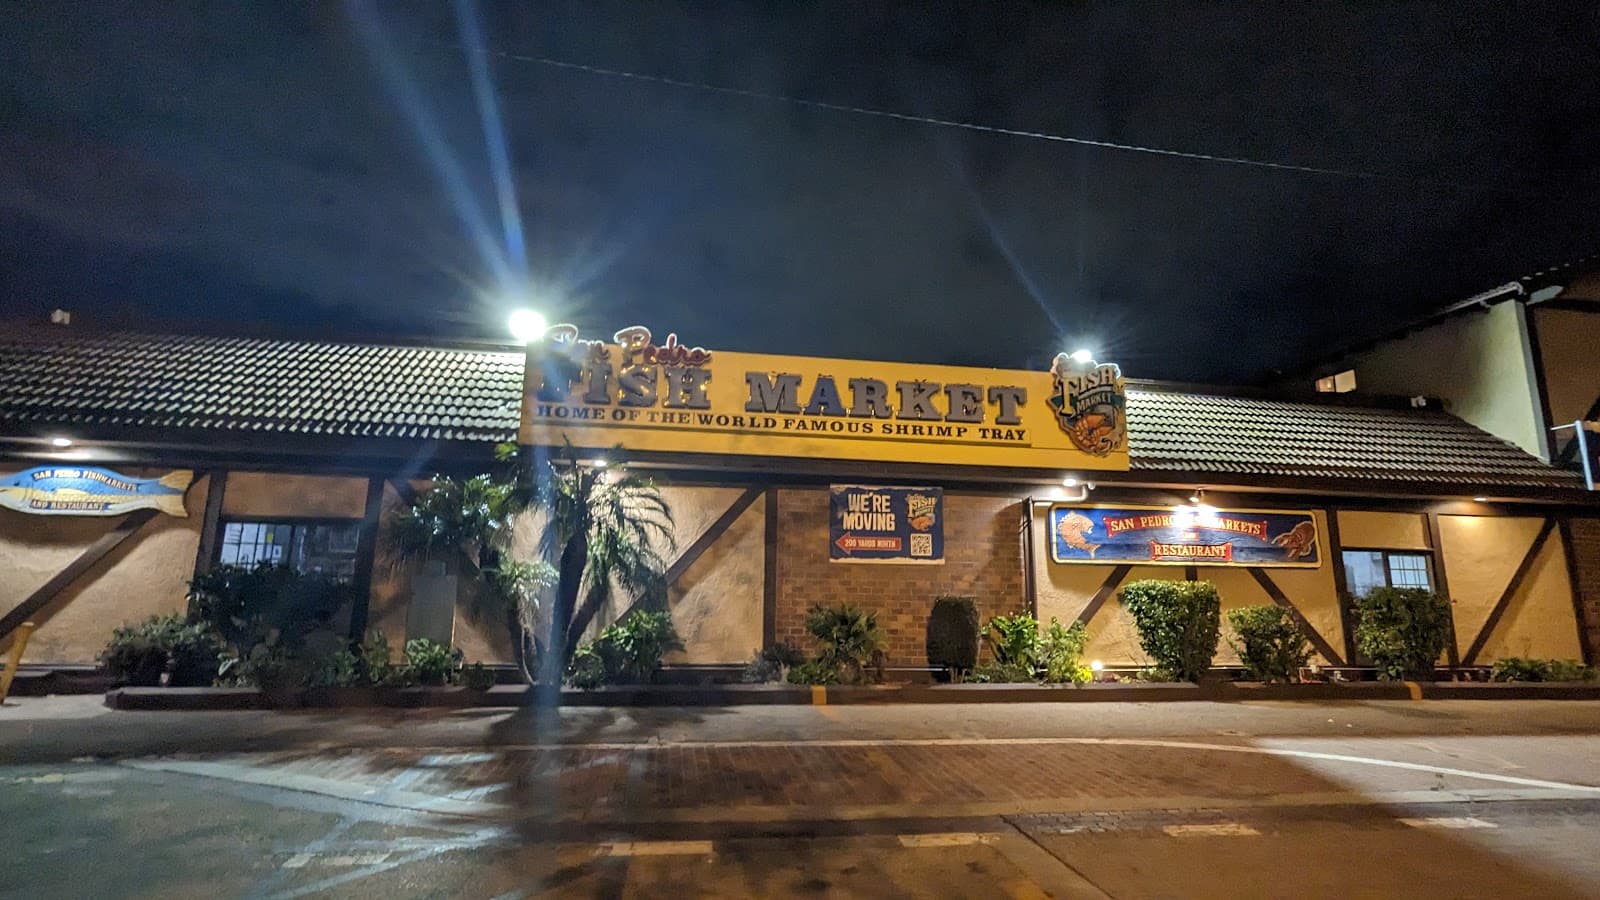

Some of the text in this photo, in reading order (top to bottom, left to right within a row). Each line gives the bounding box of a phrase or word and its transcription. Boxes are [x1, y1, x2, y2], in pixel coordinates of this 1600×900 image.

[613, 325, 713, 367] Pedro
[536, 362, 1028, 426] FISH MARKET
[1061, 366, 1115, 414] FISH
[1075, 393, 1112, 412] MARKET
[537, 405, 1027, 442] HOME OF THE WORLD FAMOUS SHRIMP TRAY
[33, 469, 51, 481] SAN
[31, 500, 47, 509] AND
[847, 492, 891, 513] WE'RE
[842, 512, 896, 532] MOVING
[1111, 518, 1135, 532] SAN
[844, 539, 857, 548] 200
[1154, 545, 1226, 557] RESTAURANT
